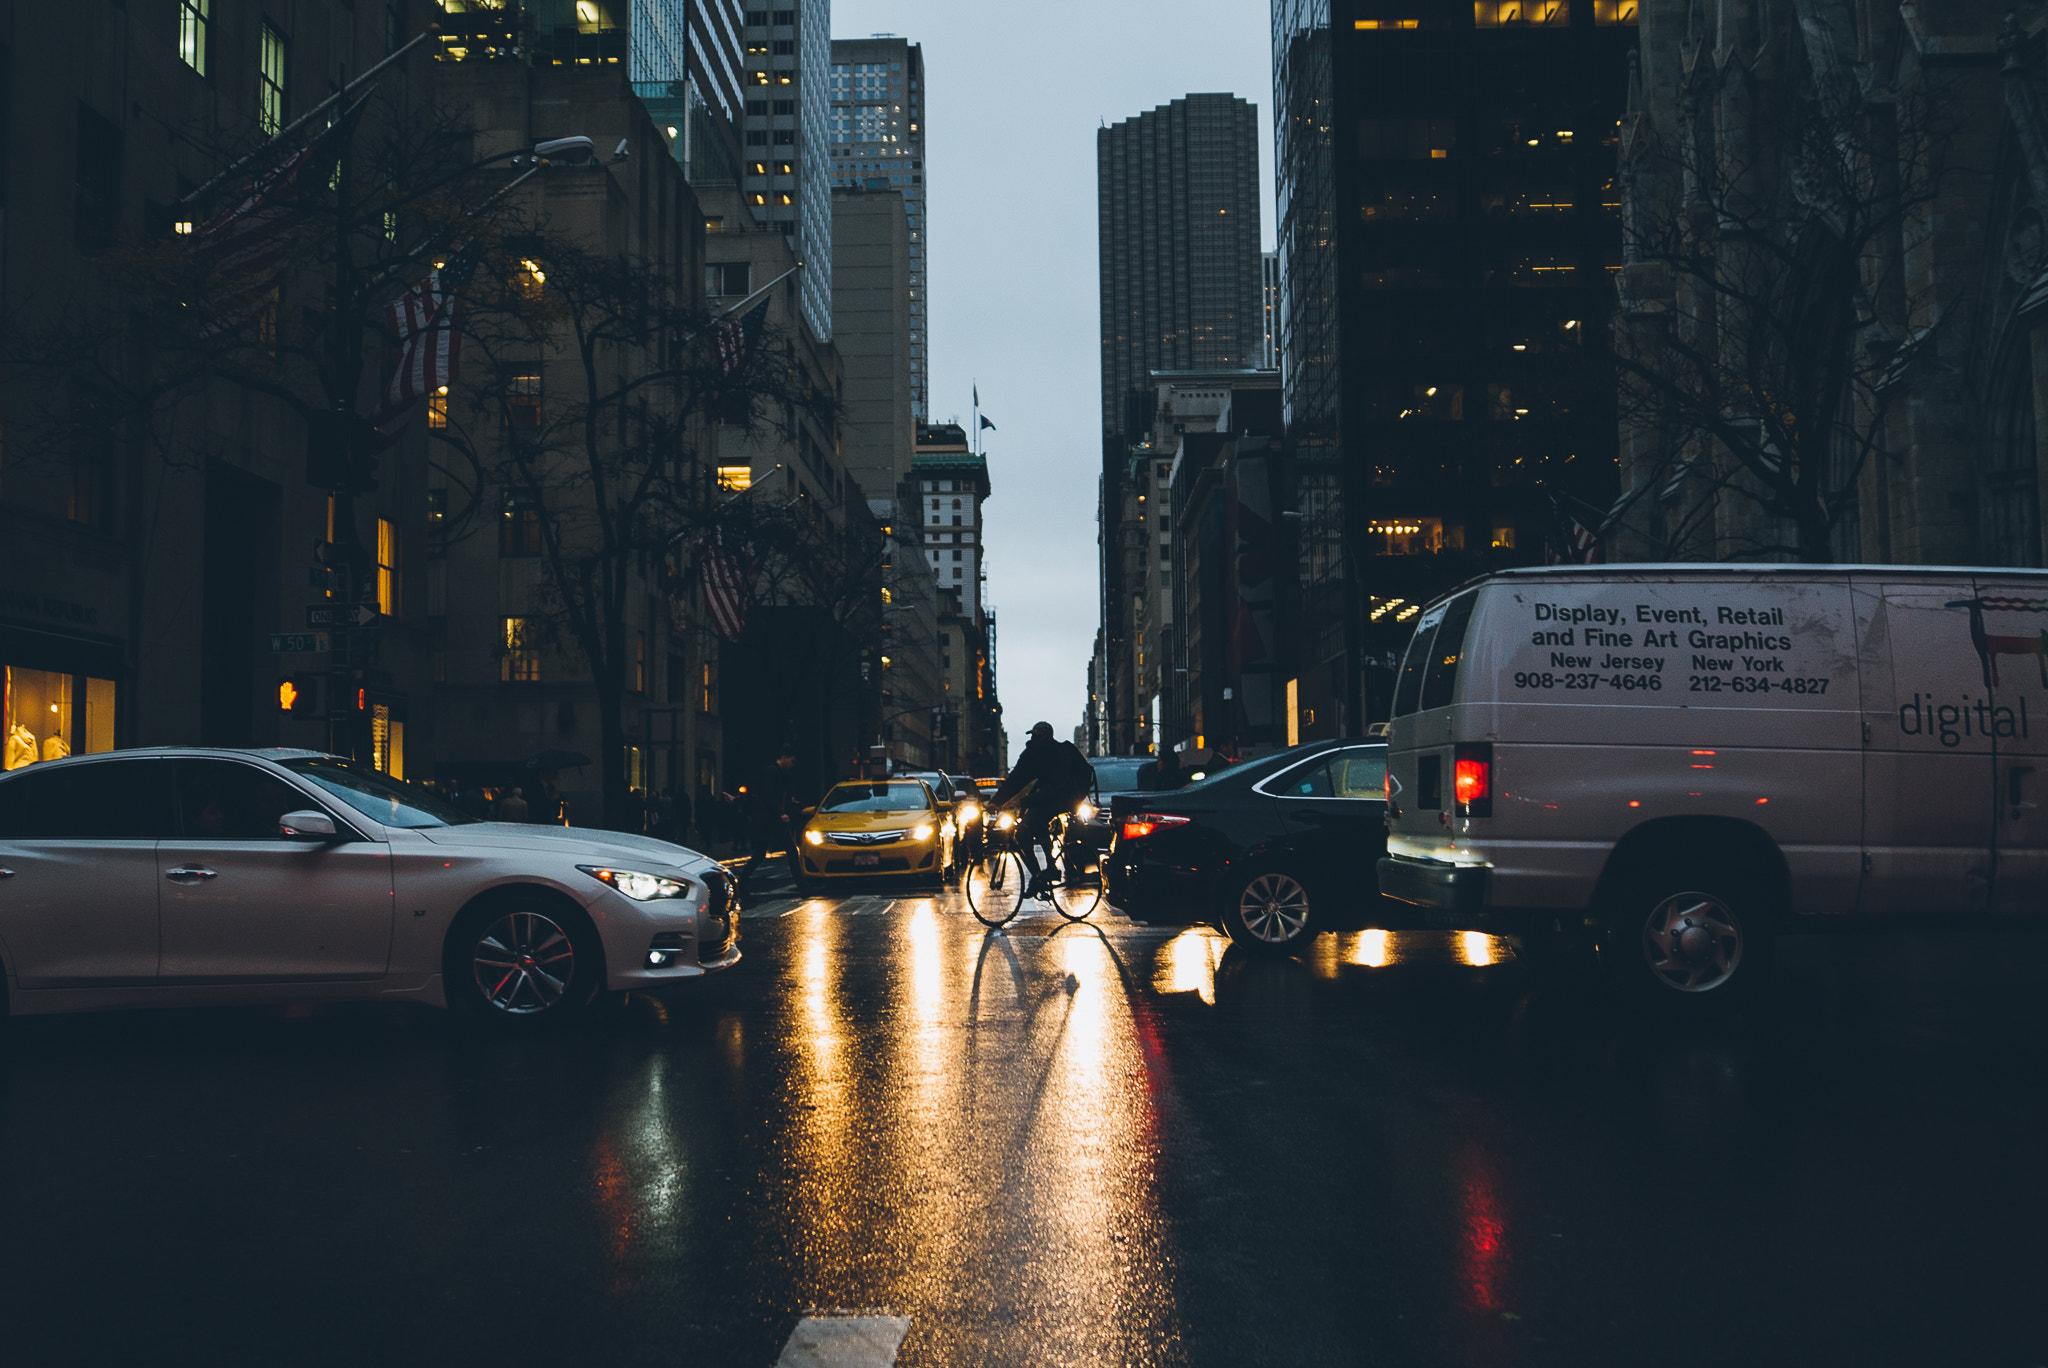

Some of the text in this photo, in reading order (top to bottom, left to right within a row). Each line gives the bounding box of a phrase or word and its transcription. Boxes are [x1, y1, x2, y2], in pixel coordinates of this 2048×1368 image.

[1535, 603, 1784, 627] Display, Event, Retail
[271, 636, 281, 651] W
[288, 636, 305, 651] 50
[1532, 628, 1791, 653] and Fine Art Graphics
[1551, 652, 1664, 673] New Jersey
[1692, 655, 1784, 672] New York
[1514, 672, 1662, 691] 908-237-4646
[1689, 676, 1829, 694] 212-634-4827
[1900, 693, 2028, 747] digital
